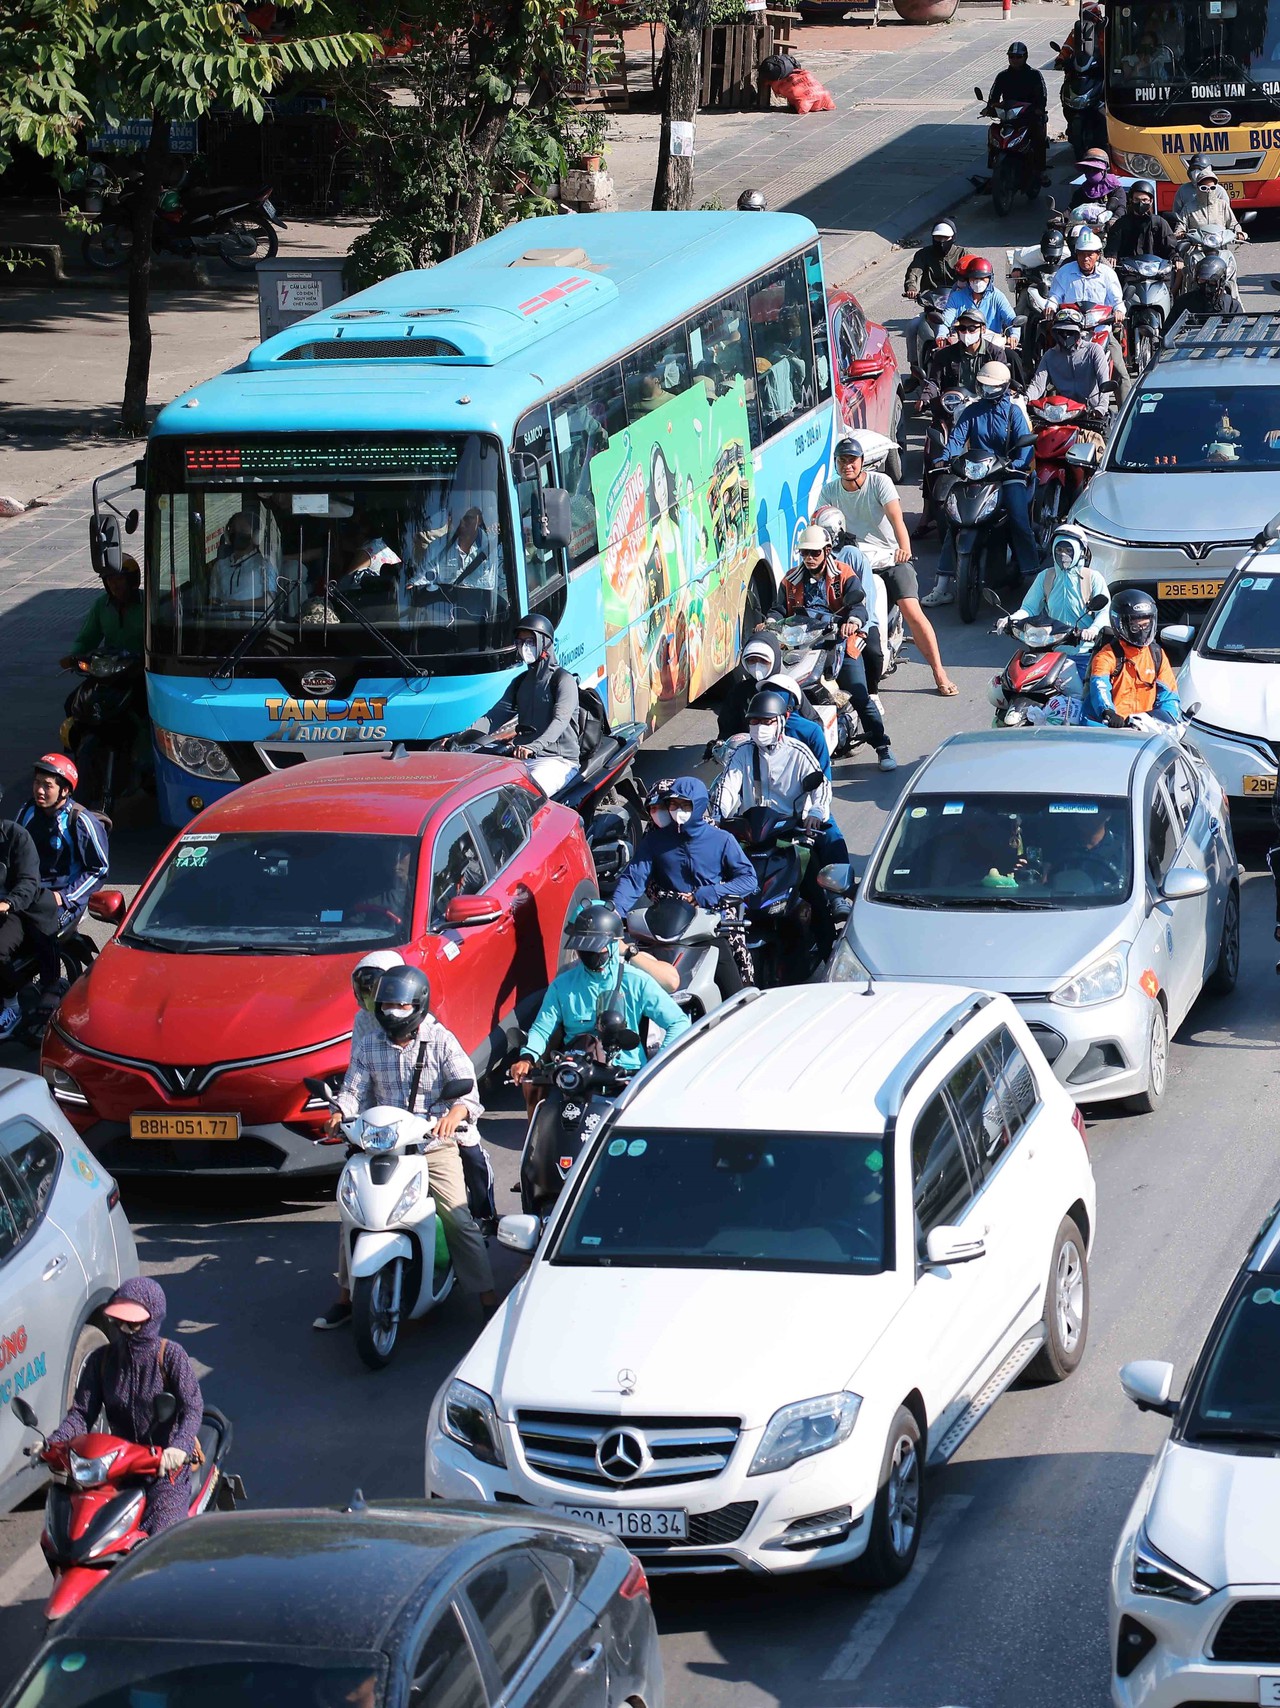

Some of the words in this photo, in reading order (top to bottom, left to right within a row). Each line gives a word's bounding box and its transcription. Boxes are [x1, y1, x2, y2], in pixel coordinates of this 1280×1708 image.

[1162, 133, 1185, 154] HA
[1190, 131, 1229, 152] NAM
[523, 424, 543, 447] SAMCO
[1165, 583, 1224, 596] 29E-512.5
[176, 857, 207, 868] TAXI
[140, 1120, 227, 1135] 88H-051.77
[14, 1351, 47, 1397] NAM
[571, 1510, 681, 1534] A-168.34
